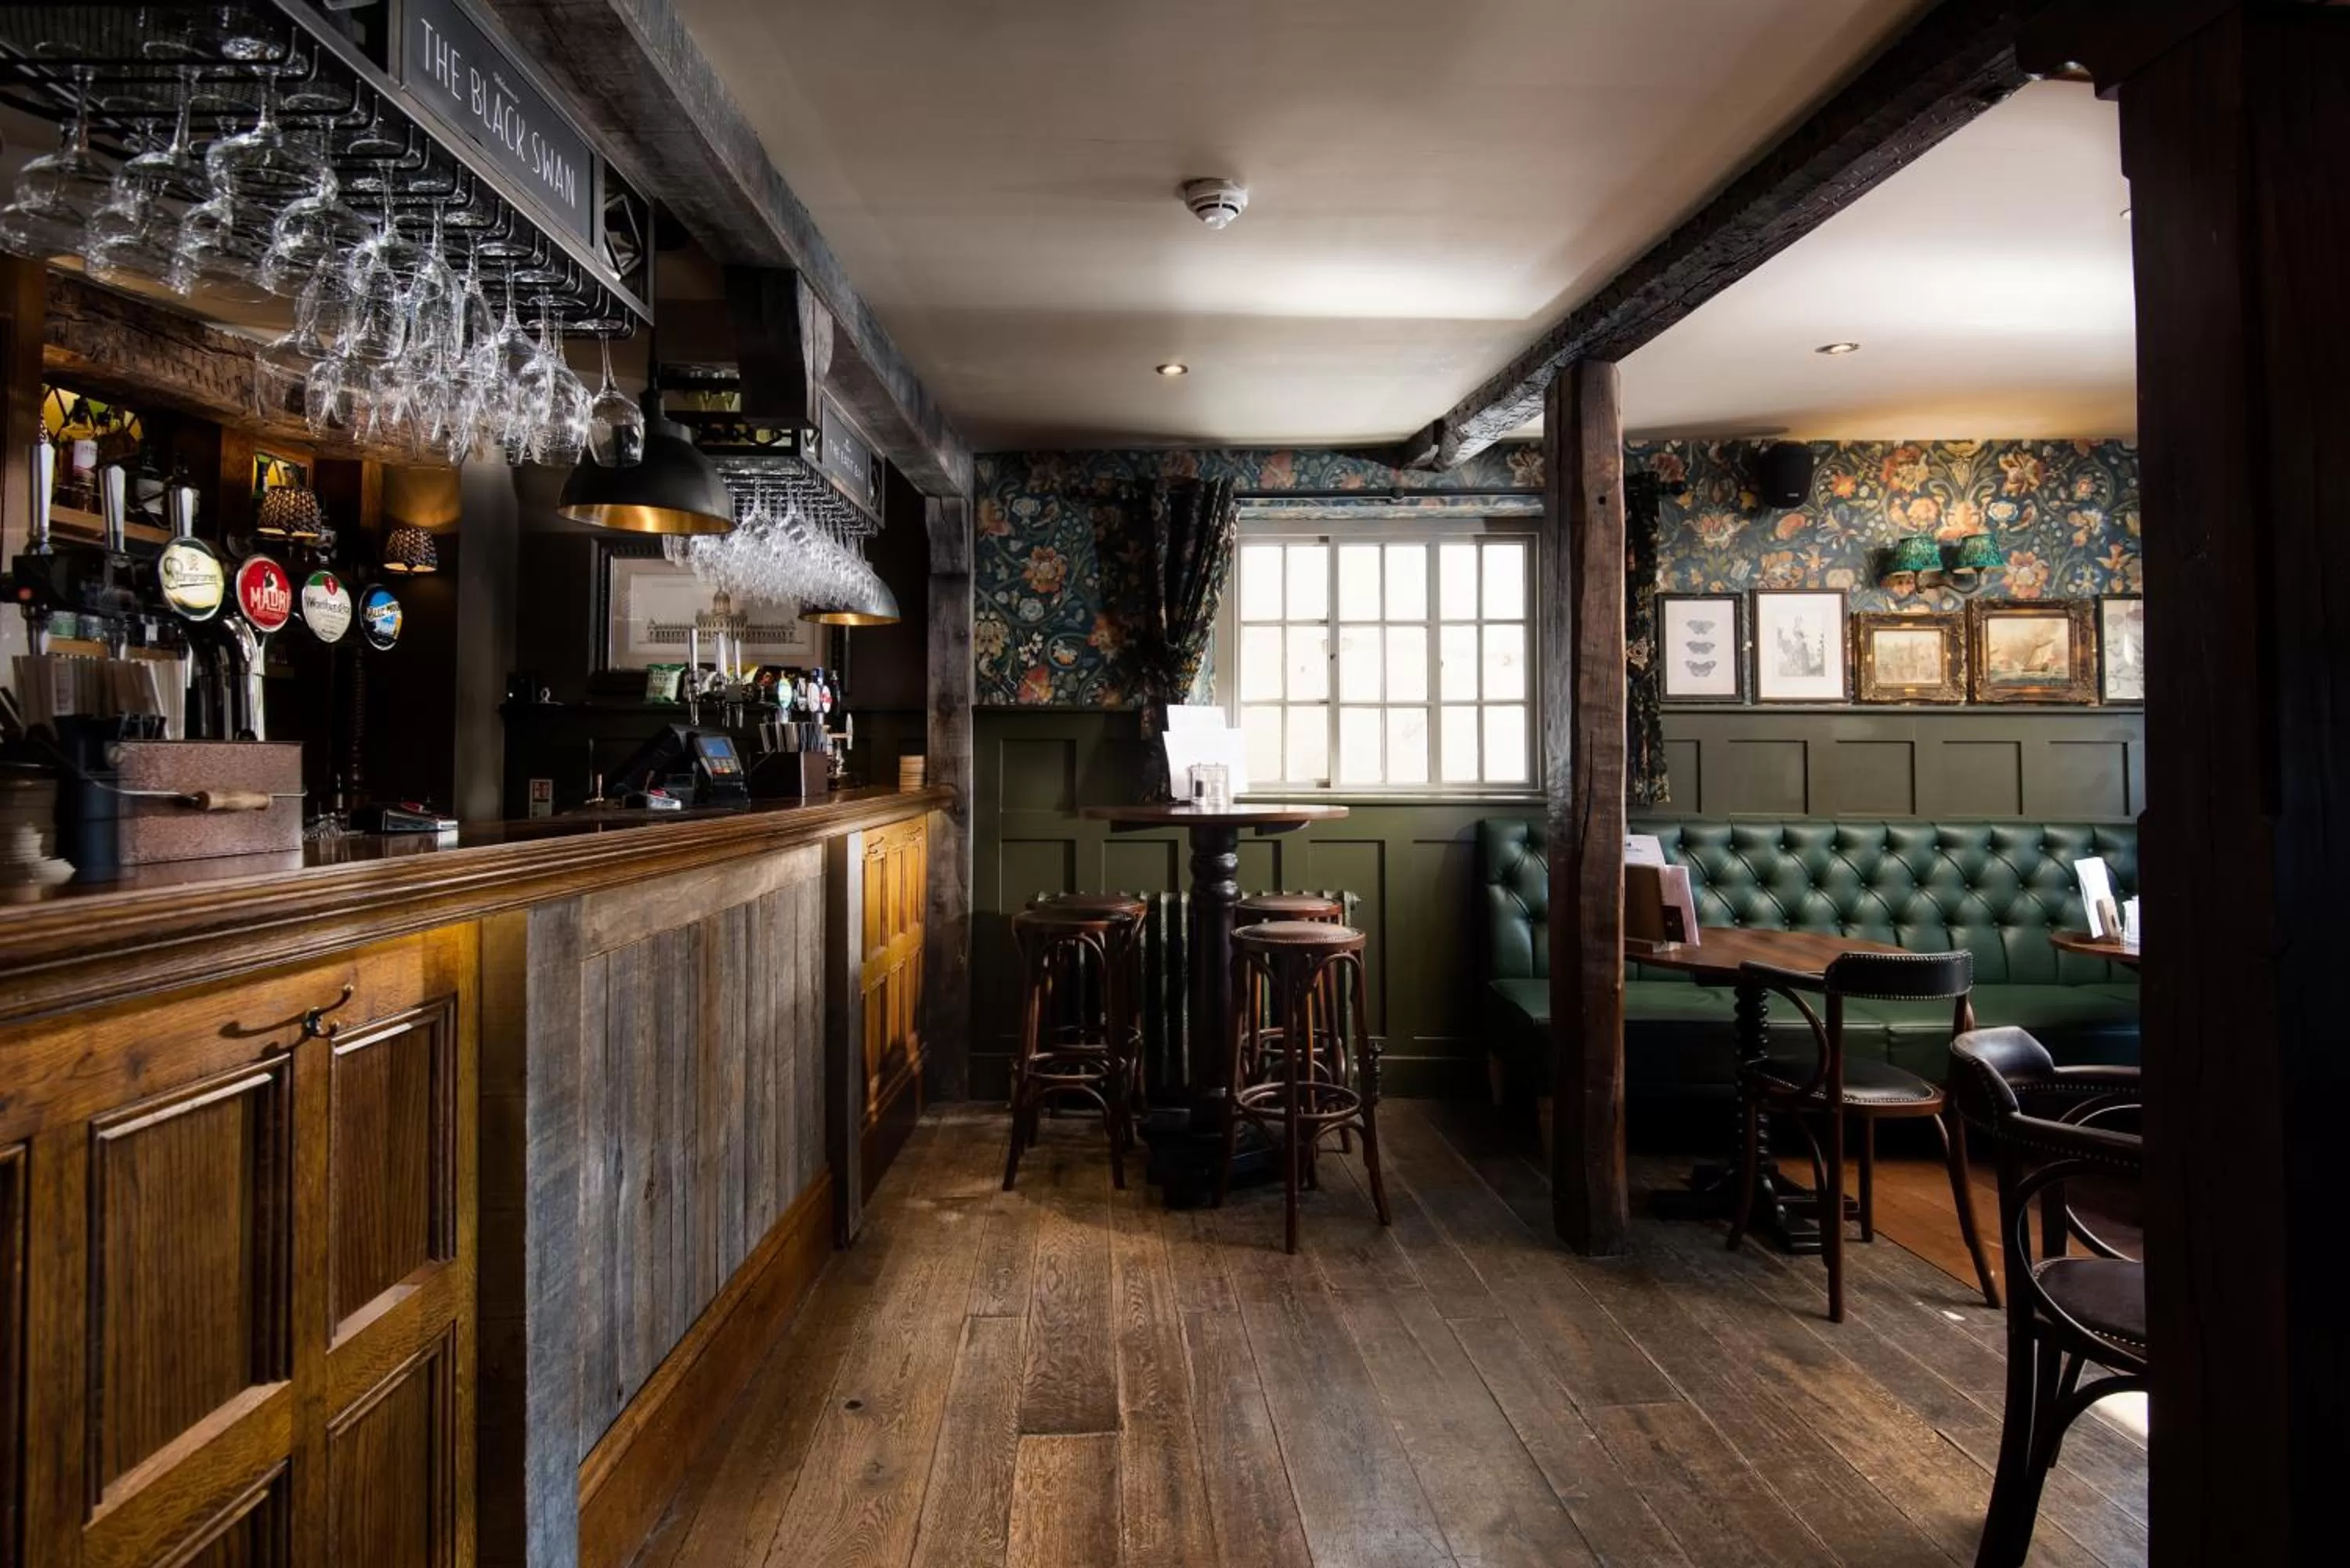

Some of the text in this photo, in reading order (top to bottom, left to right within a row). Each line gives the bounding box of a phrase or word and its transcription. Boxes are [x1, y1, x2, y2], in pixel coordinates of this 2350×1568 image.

[421, 17, 461, 101] THE
[470, 67, 526, 163] BLACK
[532, 132, 576, 208] SWAN
